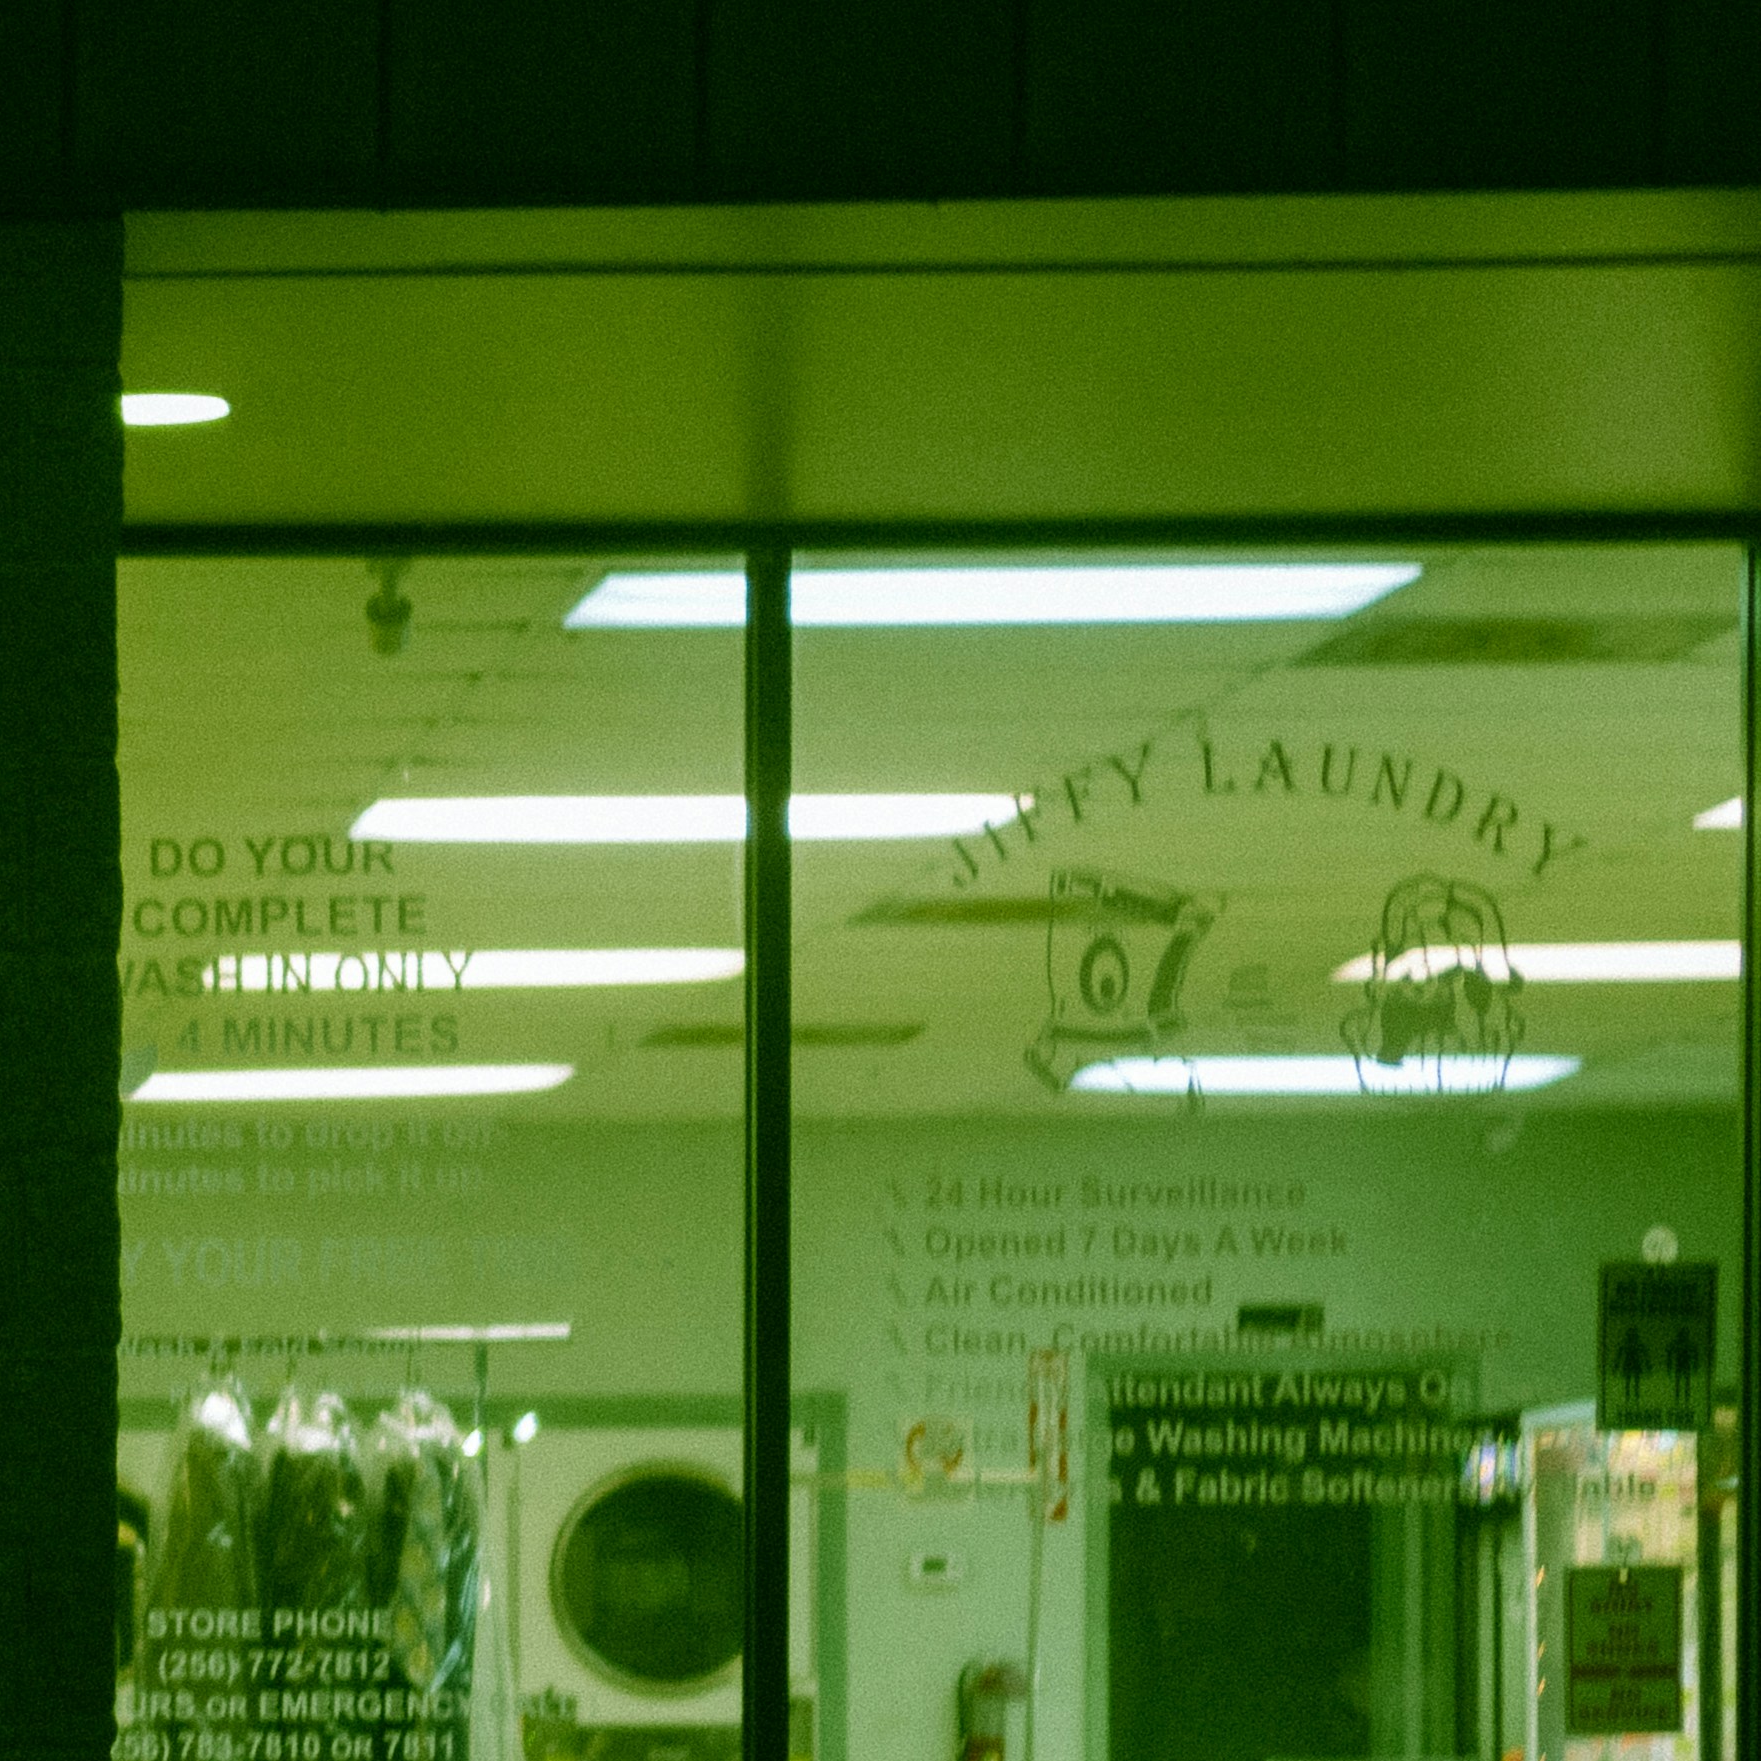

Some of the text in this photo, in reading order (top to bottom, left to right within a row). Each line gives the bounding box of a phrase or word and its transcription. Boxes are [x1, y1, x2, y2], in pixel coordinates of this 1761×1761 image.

[1202, 738, 1586, 877] LAUNDRY
[150, 838, 396, 878] DO YOUR
[133, 897, 428, 938] COMPLETE
[266, 952, 312, 993] IN
[335, 951, 473, 993] ONLY
[223, 1014, 460, 1052] MINUTES
[121, 1118, 244, 1150] inutes
[978, 1176, 1065, 1211] Hour
[1079, 1174, 1307, 1212] Surveillance
[924, 1225, 1348, 1262] Opened 7 Days A Week
[924, 1273, 1214, 1307] Air Conditioned
[1276, 1371, 1407, 1412] Always
[1146, 1419, 1308, 1460] Washing
[1175, 1468, 1283, 1503] Fabric
[147, 1607, 397, 1639] STORE PHONE
[158, 1648, 392, 1685] (256) 772-7812
[118, 1691, 196, 1720] URS
[259, 1689, 473, 1721] EMERGENCY
